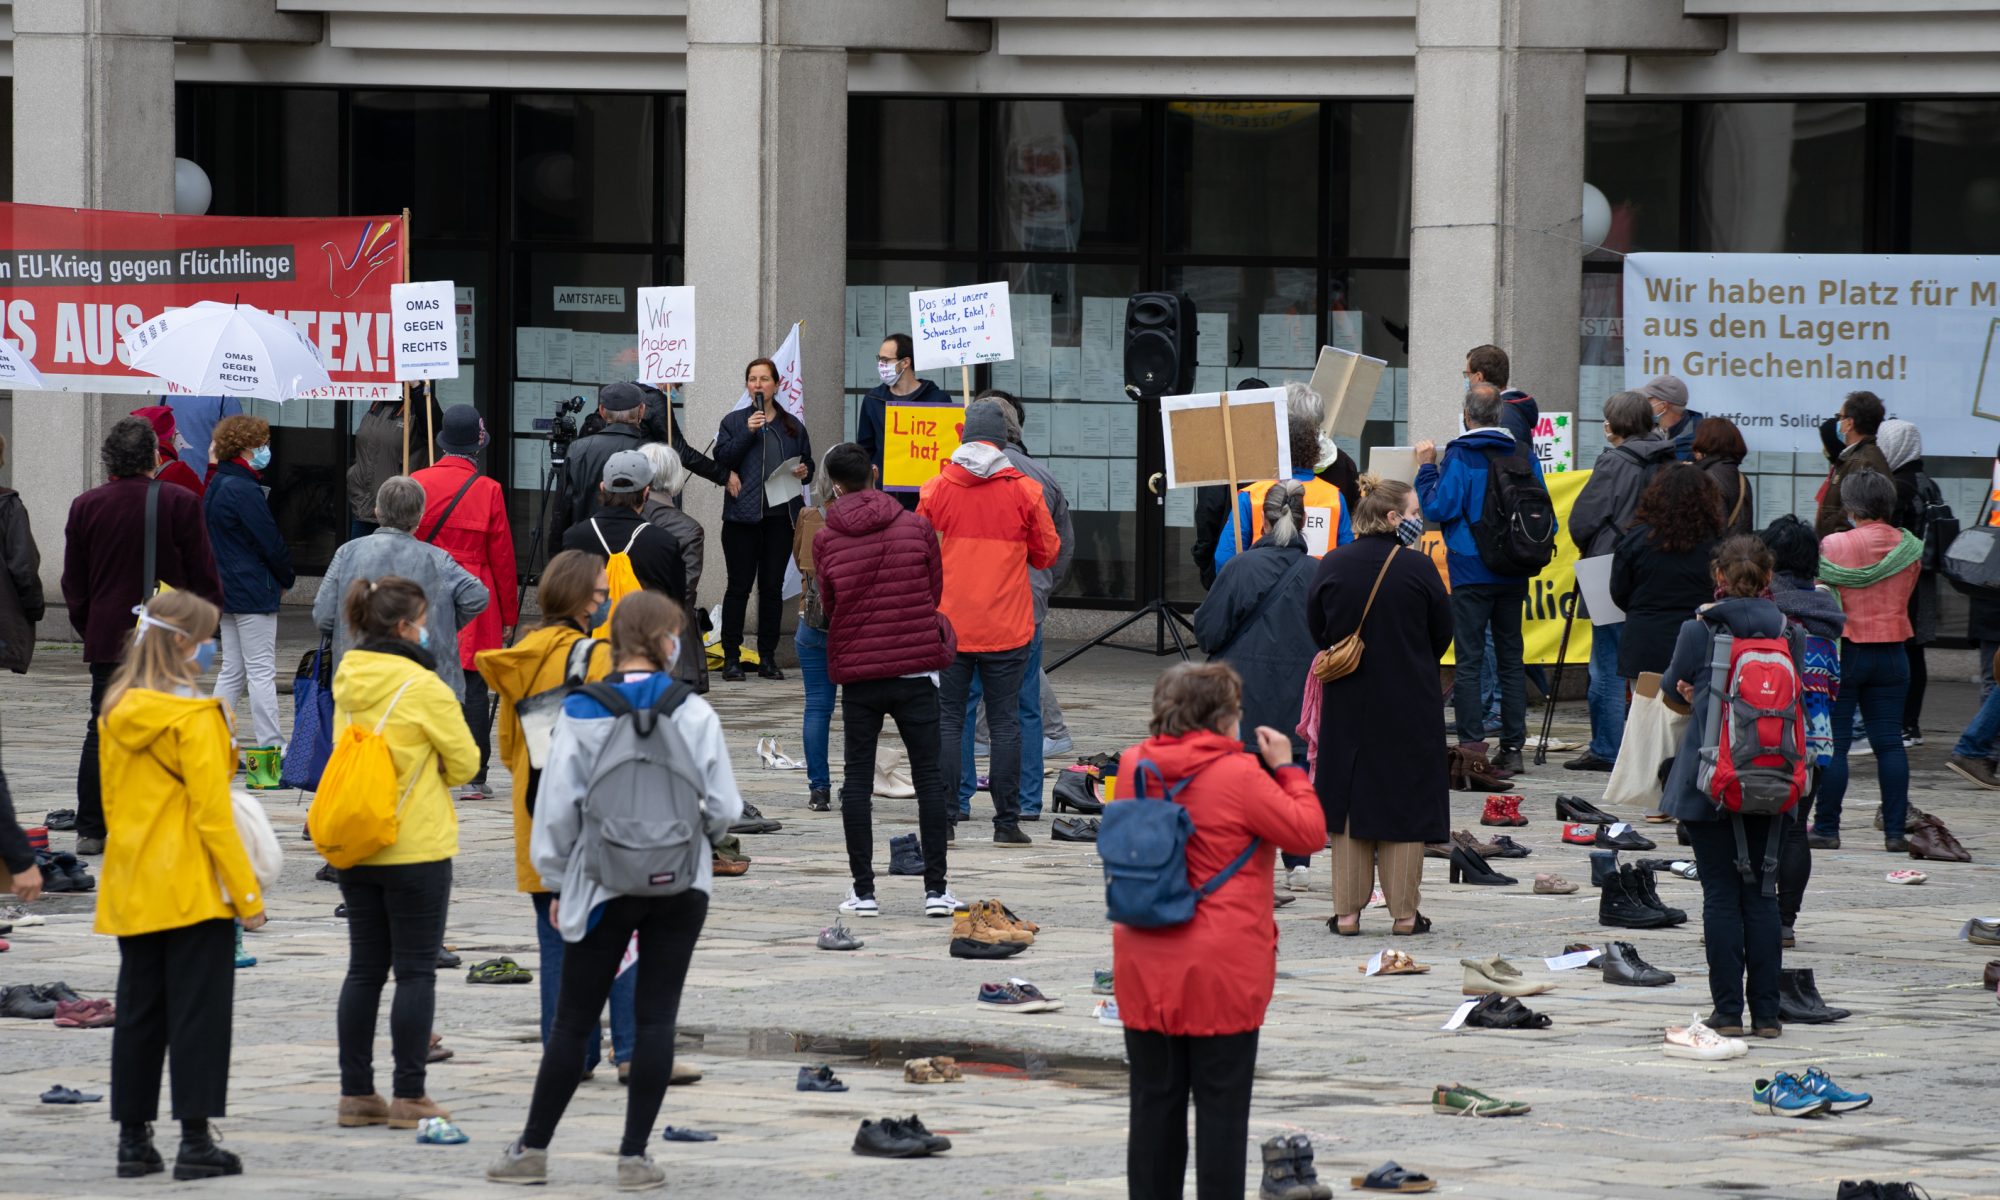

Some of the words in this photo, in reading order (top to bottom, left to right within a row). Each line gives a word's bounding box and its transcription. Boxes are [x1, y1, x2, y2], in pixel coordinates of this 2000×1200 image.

[18, 254, 103, 283] EU-Krieg
[109, 259, 171, 283] gegen
[180, 248, 290, 279] Flüchtlinge
[558, 293, 622, 305] AMTSTAFEL
[918, 298, 937, 312] Das
[941, 292, 957, 306] sind
[962, 291, 989, 303] unsere
[1645, 277, 1698, 303] Wir
[1708, 277, 1805, 304] haben
[1818, 279, 1899, 306] Platz
[1909, 279, 1959, 306] für
[1970, 281, 2000, 307] M
[406, 300, 440, 311] OMAS
[645, 296, 673, 331] Wir
[403, 320, 444, 332] GEGEN
[930, 310, 961, 323] Kinder,
[0, 299, 37, 362] S
[53, 302, 144, 366] AUS
[641, 330, 688, 351] haben
[922, 325, 967, 340] Schwestern
[973, 321, 985, 331] und
[1643, 317, 1698, 338] aus
[1709, 313, 1766, 338] den
[1779, 314, 1890, 347] Lagern
[225, 352, 254, 362] OMAS
[402, 341, 448, 353] RECHTS
[222, 363, 257, 373] GEGEN
[645, 352, 691, 380] Platz
[1643, 350, 1670, 375] in
[1683, 351, 1907, 380] Griechenland!
[219, 373, 260, 384] RECHTS
[893, 411, 937, 437] Linz
[910, 440, 940, 461] hat
